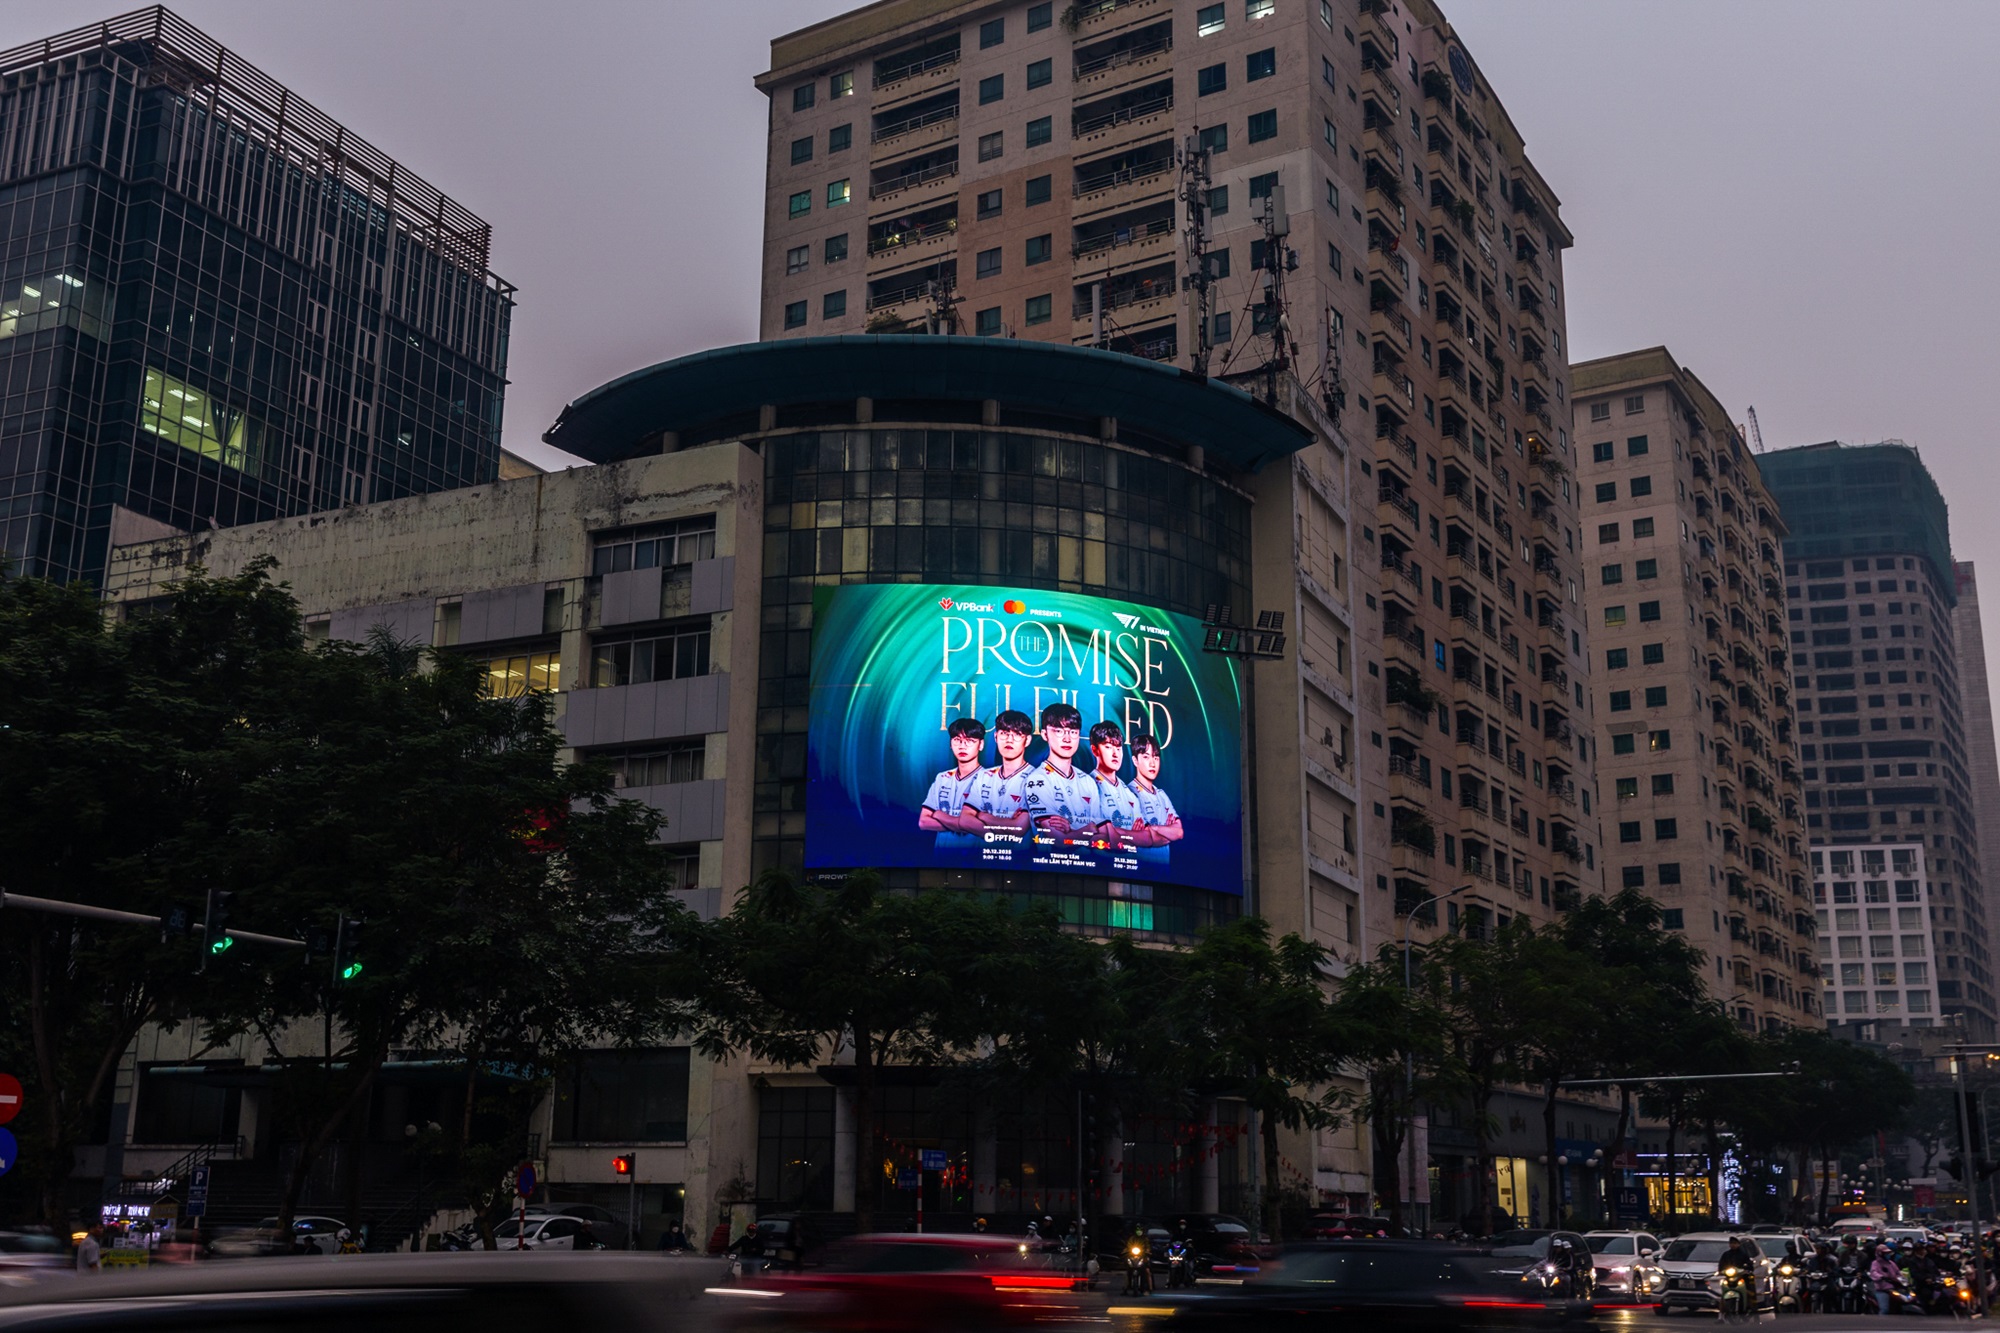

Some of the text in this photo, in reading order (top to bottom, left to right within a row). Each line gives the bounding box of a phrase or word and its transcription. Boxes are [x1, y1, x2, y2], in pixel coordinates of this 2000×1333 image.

[955, 602, 1062, 618] VPBank PRESENTS
[1147, 626, 1170, 636] VIETNAM
[1017, 635, 1046, 653] THE
[940, 616, 1171, 697] PROMISE
[939, 681, 1174, 751] FUFED
[994, 834, 1023, 844] FPT Play
[1050, 852, 1068, 860] TRUNG
